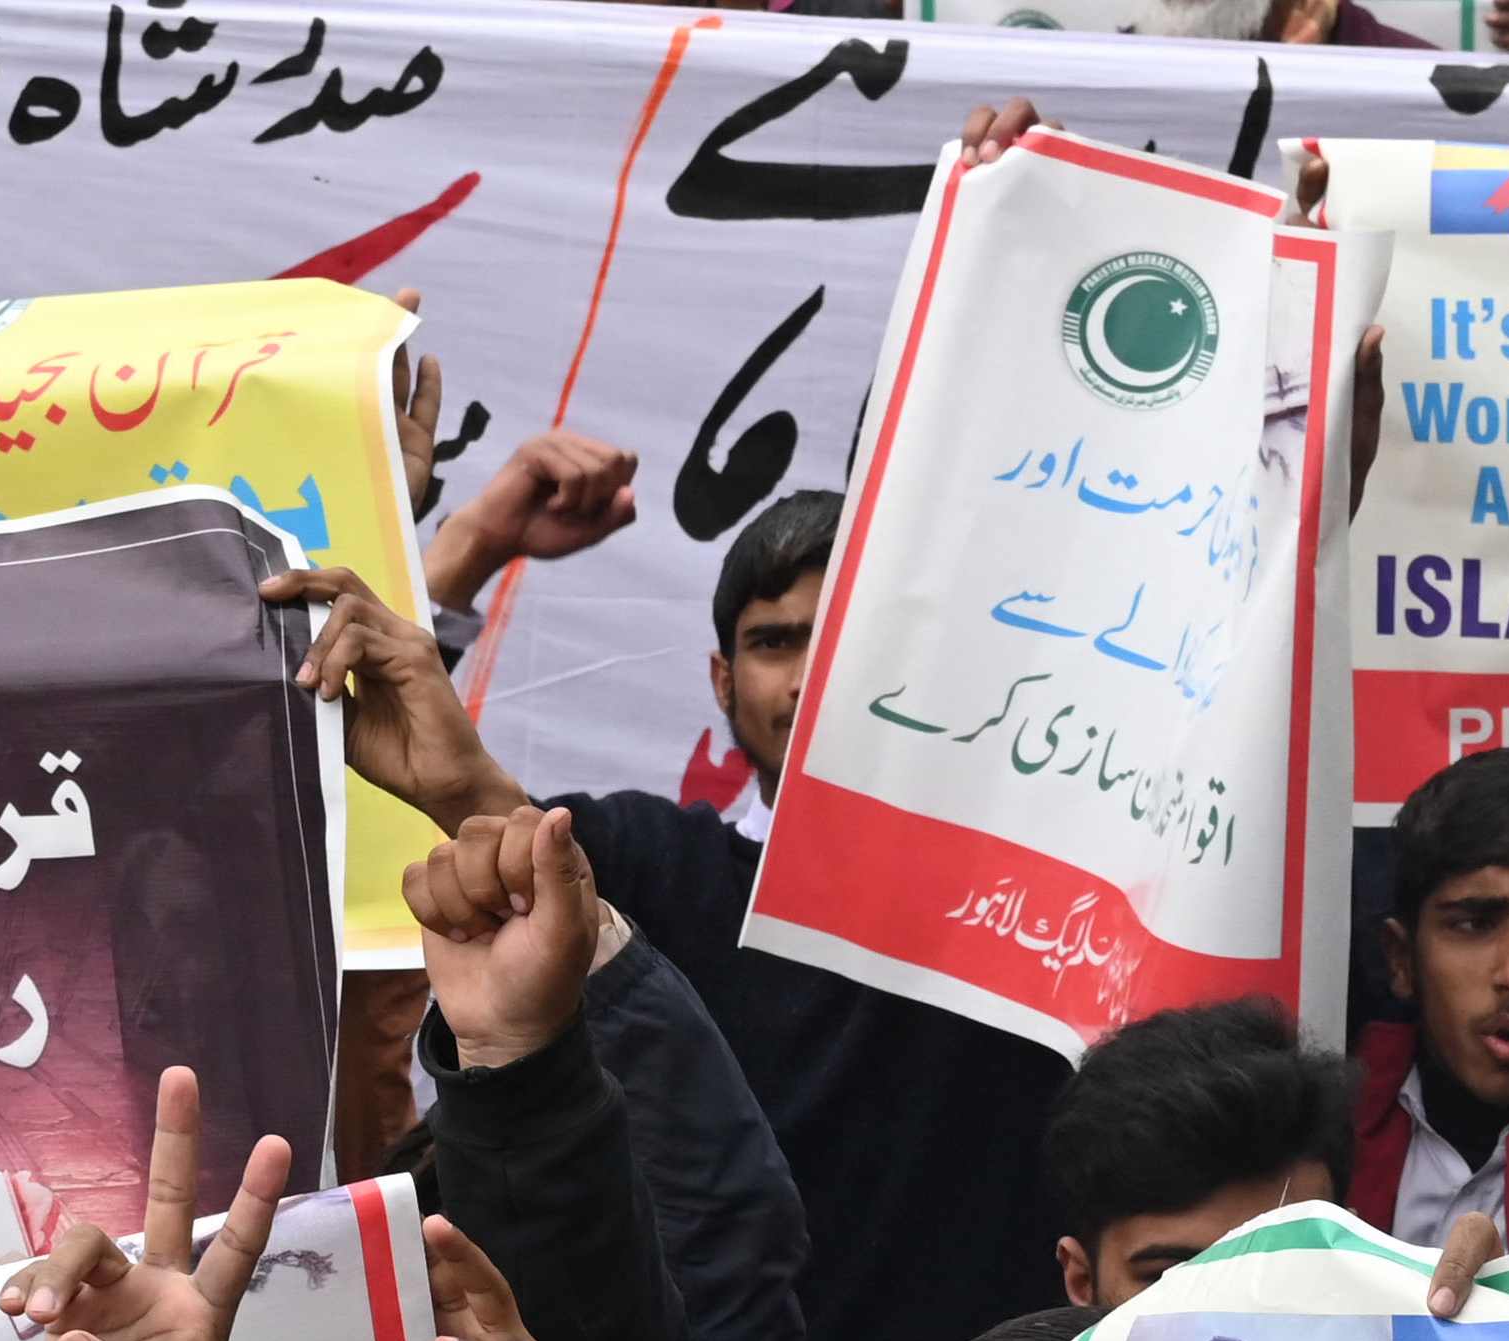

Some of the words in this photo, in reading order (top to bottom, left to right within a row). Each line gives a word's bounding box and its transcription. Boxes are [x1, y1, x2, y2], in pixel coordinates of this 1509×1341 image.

[252, 17, 444, 144] صدر
[993, 436, 1085, 489] اور
[990, 590, 1089, 638] سے
[868, 673, 1053, 743] کرے
[1011, 704, 1139, 792] سازی
[945, 876, 1029, 938] لاہور
[1014, 891, 1099, 971] لیگ
